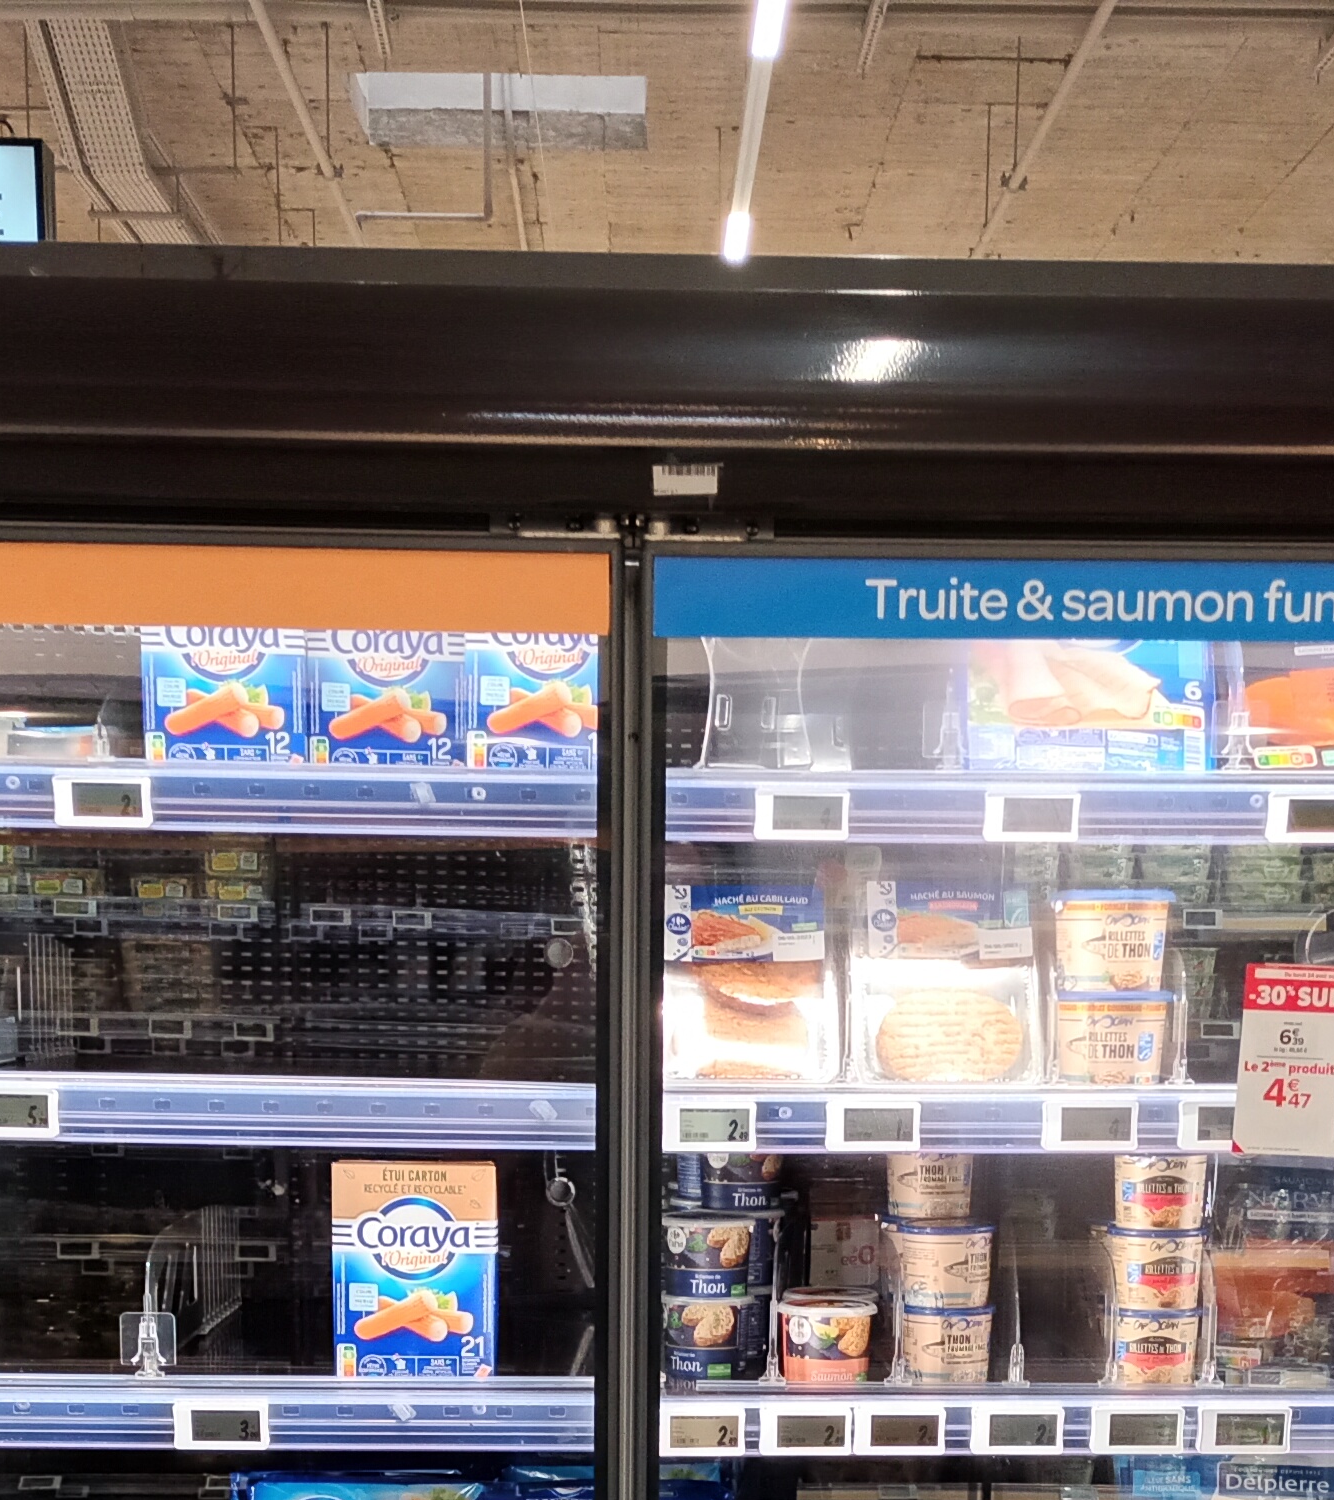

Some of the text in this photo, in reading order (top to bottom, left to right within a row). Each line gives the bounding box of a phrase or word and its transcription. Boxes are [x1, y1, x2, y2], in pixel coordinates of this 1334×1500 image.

[866, 577, 1008, 621] Truite
[1017, 579, 1053, 621] &
[1063, 587, 1252, 622] saumon
[1184, 680, 1202, 700] 6
[266, 731, 290, 755] 12
[428, 737, 451, 760] 12
[714, 894, 808, 906] HACHÉ AU CABILLAUD
[910, 890, 995, 901] HACHÉ AU SAUMON
[1108, 931, 1145, 943] RILLETTES
[1107, 943, 1152, 959] DE THON
[1088, 1031, 1128, 1043] RILLETTES
[1087, 1043, 1134, 1059] DE THON
[1244, 1061, 1259, 1072] Le
[1289, 1062, 1334, 1076] produit
[382, 1166, 447, 1182] ÉTUI CARTON
[732, 1190, 766, 1207] Thon
[357, 1216, 470, 1253] Coraya
[382, 1249, 448, 1270] l'Original
[689, 1278, 727, 1295] Thon
[461, 1336, 485, 1358] 21
[670, 1355, 702, 1373] Thon
[1225, 1471, 1330, 1500] Delpierre
